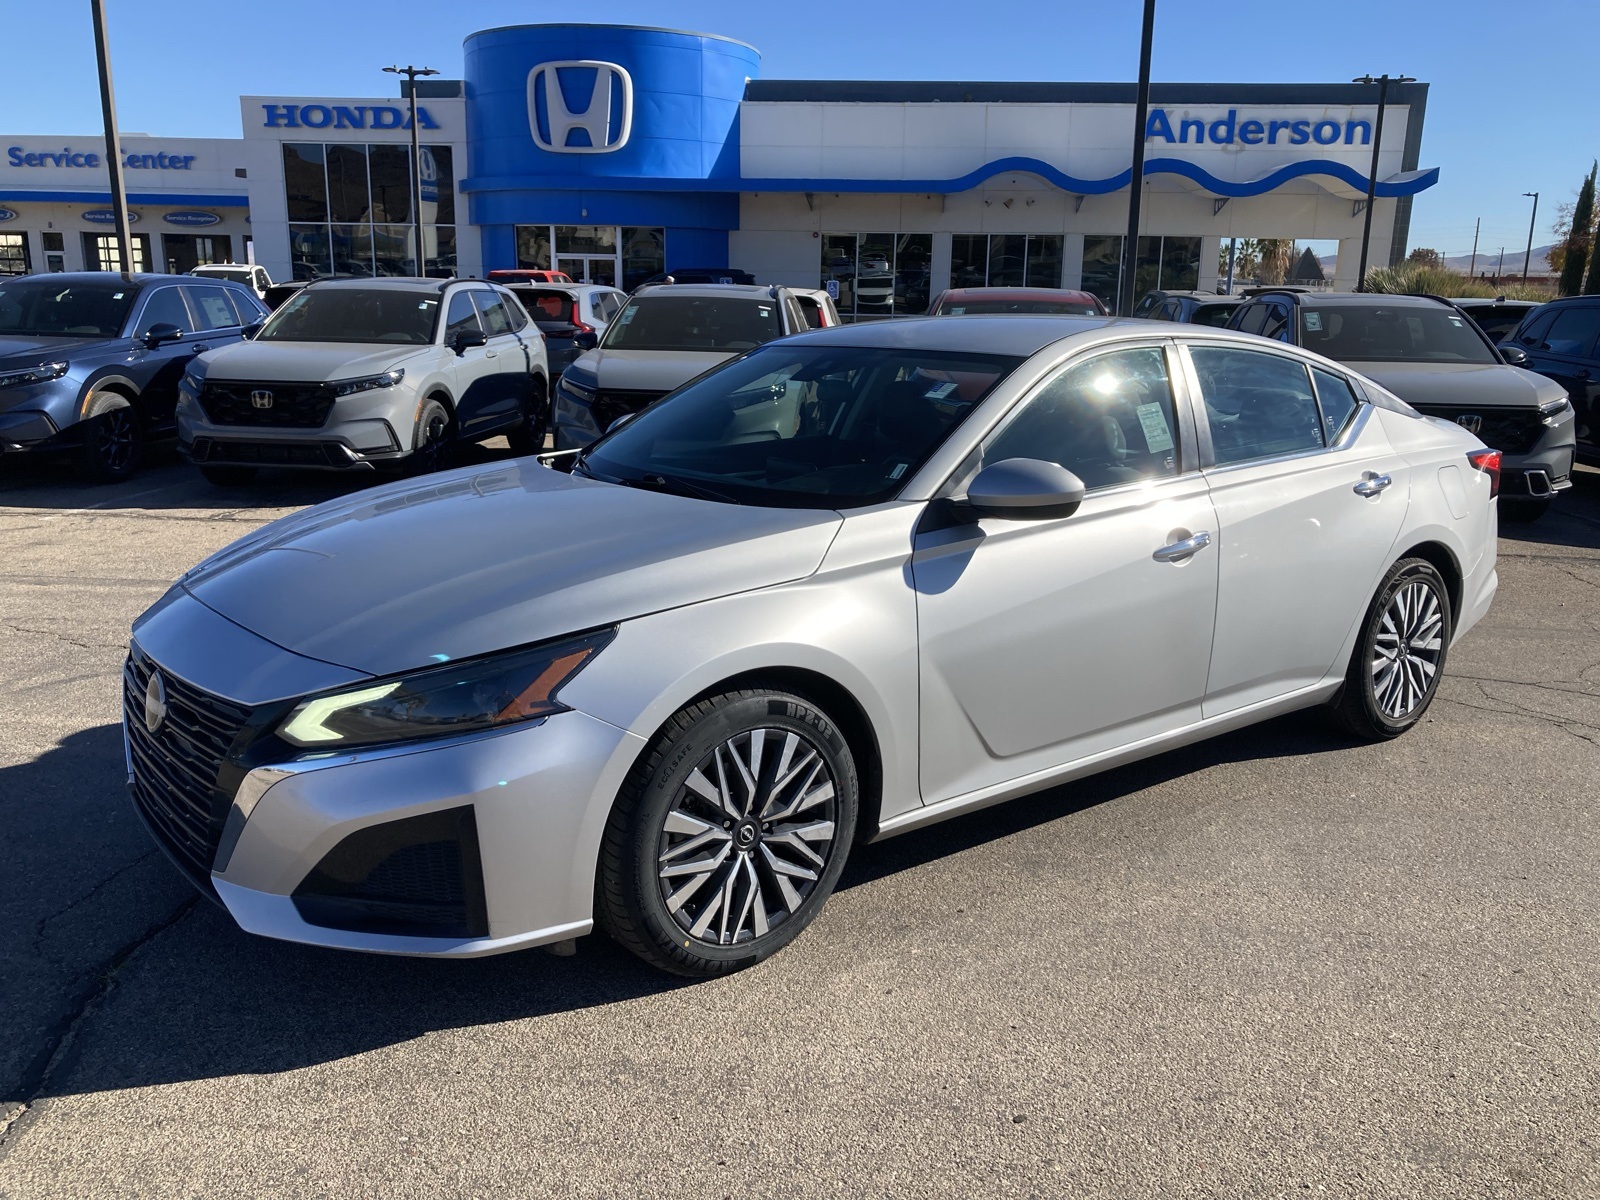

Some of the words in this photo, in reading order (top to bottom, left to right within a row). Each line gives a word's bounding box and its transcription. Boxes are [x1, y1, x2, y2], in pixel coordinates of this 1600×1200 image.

[262, 104, 441, 130] HONDA
[1145, 108, 1371, 145] Anderson
[7, 146, 100, 168] Service
[120, 148, 195, 170] enter
